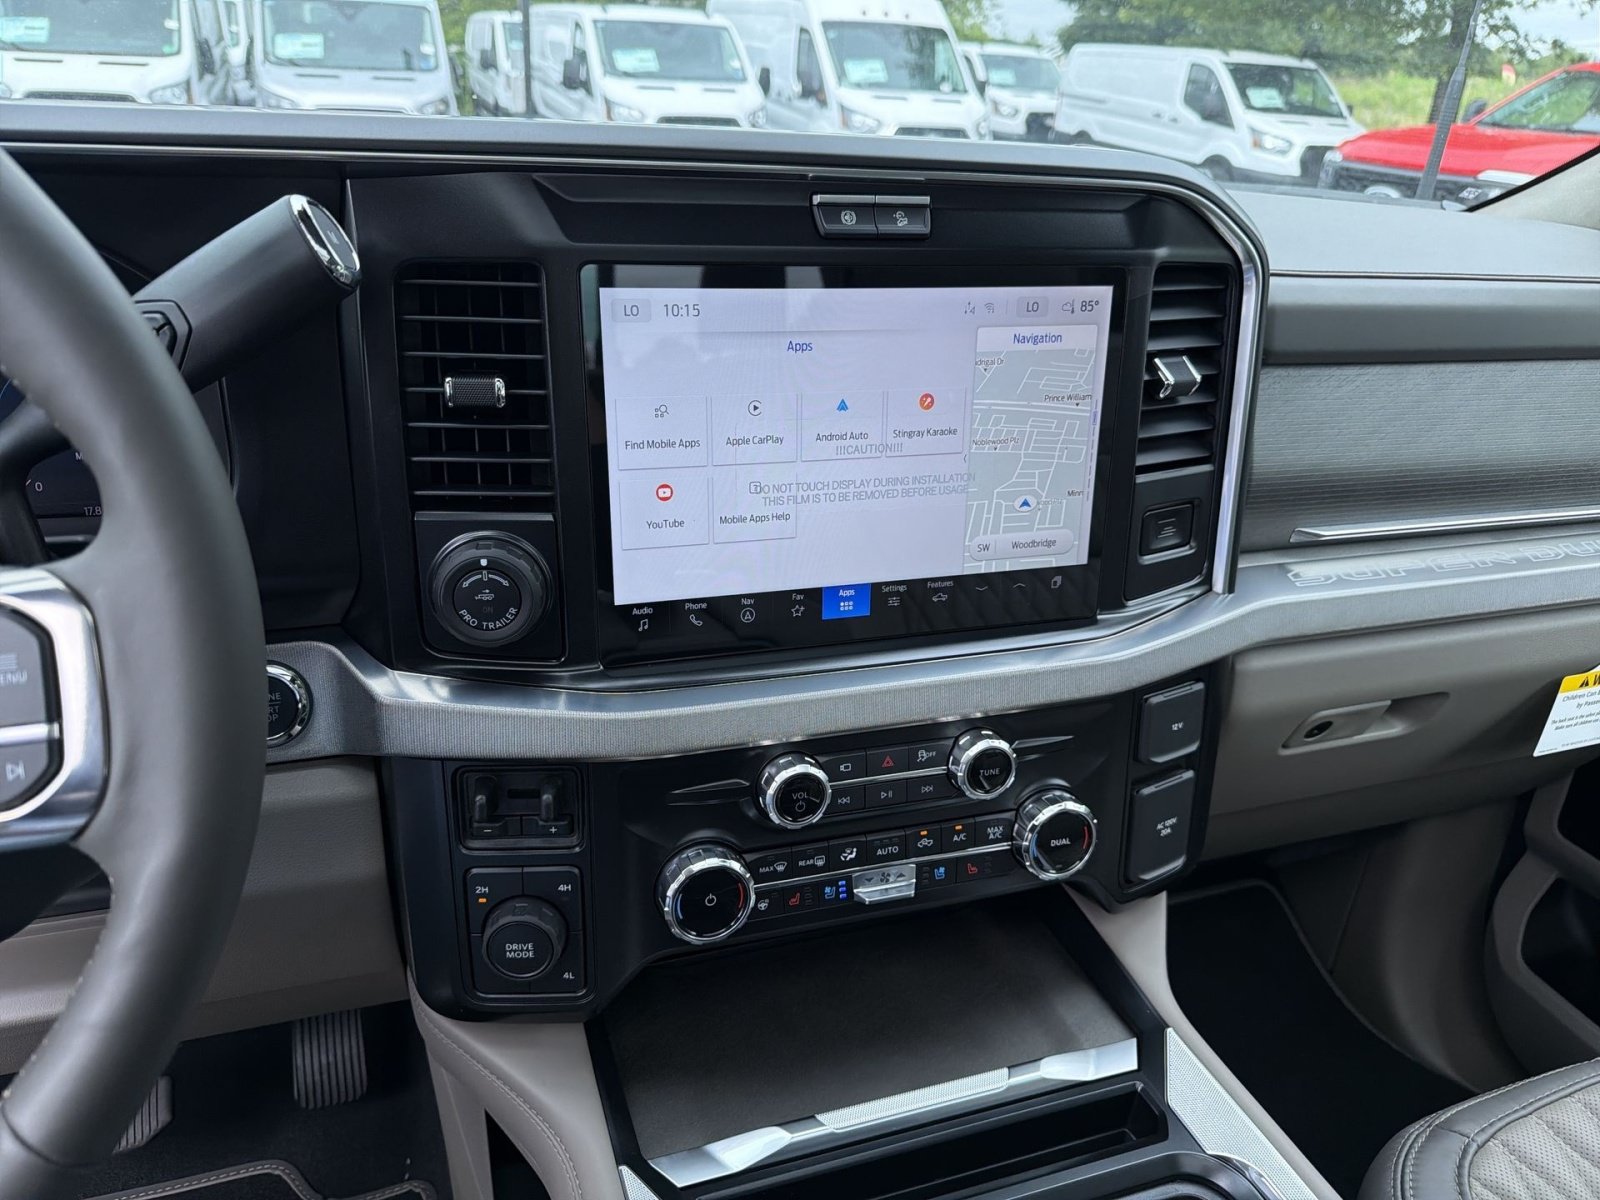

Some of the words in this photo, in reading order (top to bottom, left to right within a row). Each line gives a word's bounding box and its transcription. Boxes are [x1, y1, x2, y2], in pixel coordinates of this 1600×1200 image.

[624, 304, 640, 318] LO
[662, 304, 700, 318] 10:15
[1026, 302, 1039, 312] LO
[1012, 333, 1063, 345] Navigation
[786, 340, 814, 354] Apps
[1044, 394, 1065, 402] Prince
[1066, 393, 1092, 401] William
[815, 432, 848, 442] Android
[848, 431, 868, 440] Auto
[892, 428, 926, 440] Stingray
[926, 426, 958, 437] Karaoke
[624, 440, 644, 450] Find
[646, 438, 676, 450] Mobile
[678, 438, 700, 449] Apps
[726, 436, 750, 447] Apple
[752, 435, 784, 446] CarPlay
[972, 438, 1009, 446] Noblewood
[35, 482, 43, 492] 0
[772, 482, 794, 494] NOT
[795, 480, 830, 492] TOUCH
[832, 478, 872, 490] DISPLAY
[873, 476, 910, 488] DURING
[912, 472, 976, 486] INSTALLATION
[762, 496, 785, 506] THIS
[786, 494, 810, 504] FILM
[812, 493, 820, 504] IS
[822, 492, 836, 502] TO
[838, 491, 851, 502] BE
[852, 488, 900, 501] REMOVED
[901, 486, 937, 498] BEFORE
[939, 484, 969, 495] USAGE
[720, 515, 748, 525] Mobile
[749, 514, 770, 524] Apps
[772, 512, 791, 522] Help
[646, 519, 685, 530] YouTube
[977, 544, 990, 552] SW
[1012, 538, 1057, 550] Woodbridge
[1286, 552, 1517, 586] SUPER
[882, 584, 907, 593] Settings
[927, 580, 954, 589] Features
[838, 588, 856, 598] Apps
[632, 606, 654, 615] Audio
[685, 602, 708, 610] Phone
[458, 609, 478, 627] PRO
[482, 607, 518, 630] TRAILER
[1563, 694, 1585, 702] Children
[979, 768, 1001, 777] TUNE
[792, 792, 809, 800] VOL
[986, 826, 1004, 834] MAX
[1156, 821, 1164, 830] AC
[952, 832, 968, 842] A/C
[988, 832, 1002, 840] A/C
[1050, 837, 1071, 847] DUAL
[876, 846, 899, 856] AUTO
[798, 858, 814, 867] REAR
[475, 886, 489, 894] 2H
[558, 884, 572, 892] 4H
[505, 942, 534, 951] DRIVE
[506, 950, 535, 958] MODE
[563, 971, 575, 980] 4L
